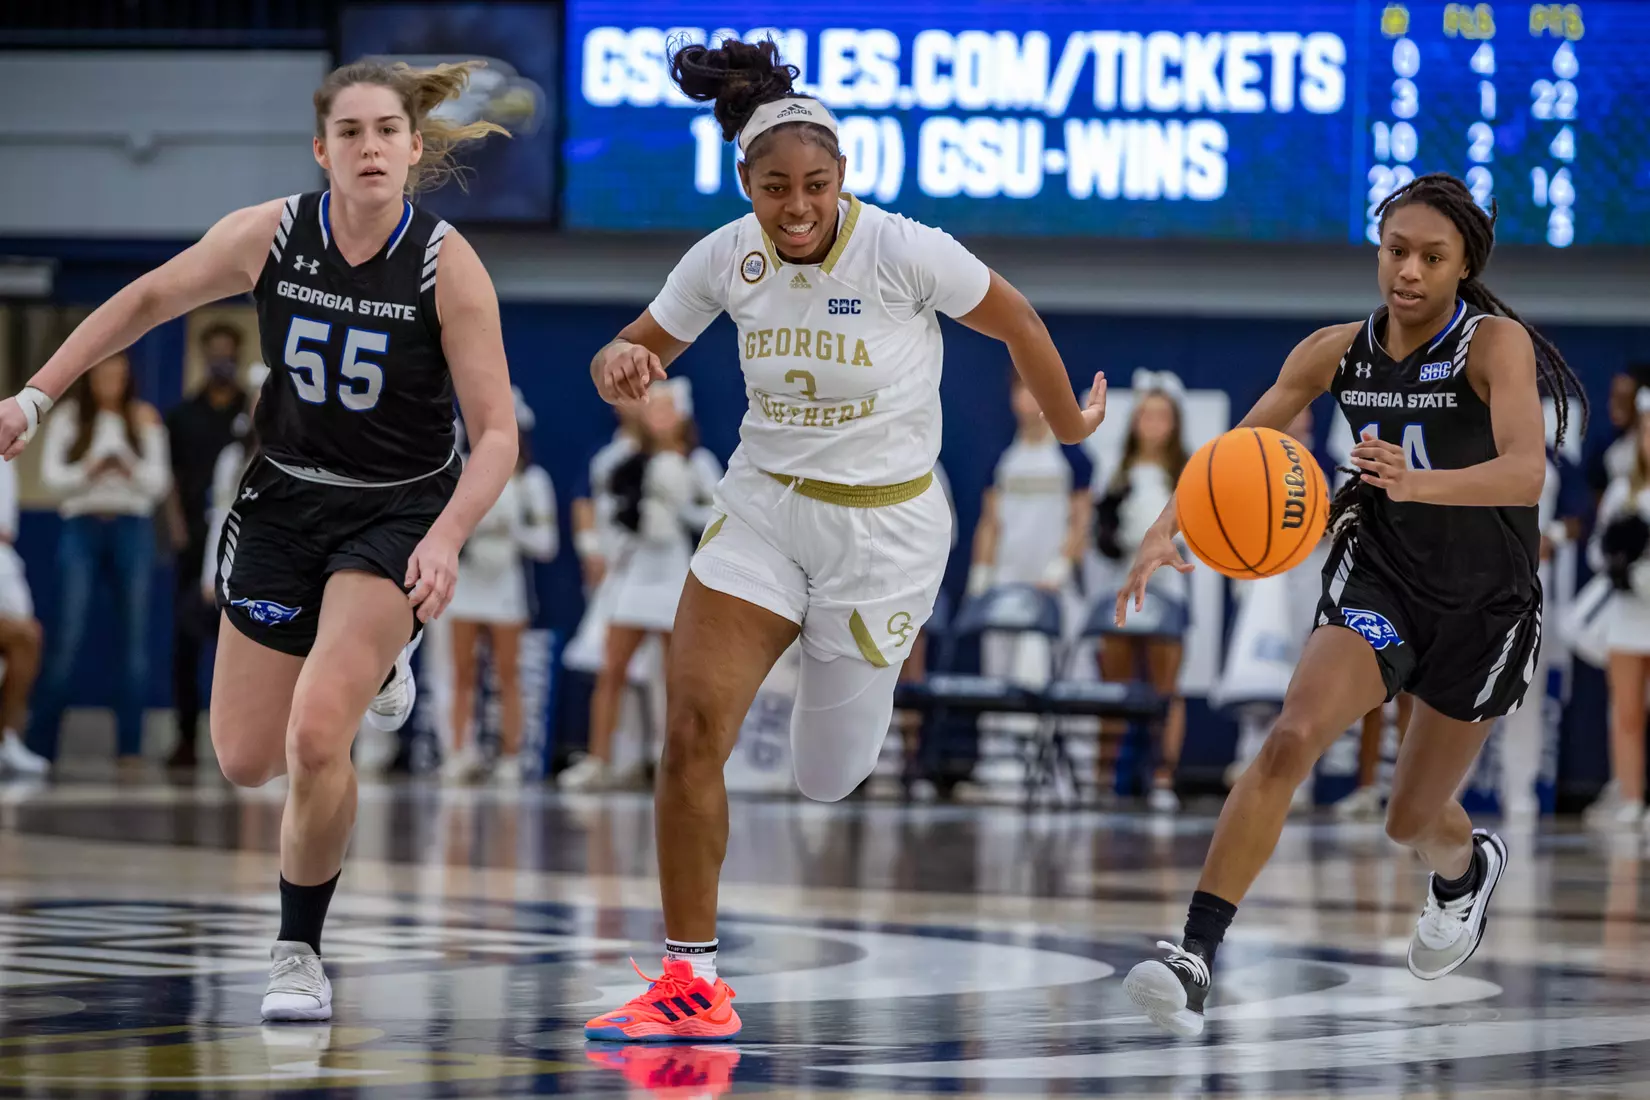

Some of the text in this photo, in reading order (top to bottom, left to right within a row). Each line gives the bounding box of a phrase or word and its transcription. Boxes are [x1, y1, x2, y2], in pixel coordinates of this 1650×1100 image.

[582, 27, 1346, 116] GSLES.COM/TICKETS
[777, 109, 812, 118] adidas
[1391, 78, 1578, 119] 3 1 22
[919, 117, 1228, 200] GSU-WINS
[1372, 121, 1574, 162] 10 2 4
[277, 281, 416, 321] GEORGIA STATE
[828, 299, 861, 314] SBC
[284, 314, 390, 412] 55
[745, 327, 873, 367] GEORGIA
[1419, 361, 1451, 381] SBC
[1340, 390, 1457, 408] GEORGIA STATE
[1279, 438, 1307, 530] Wilson
